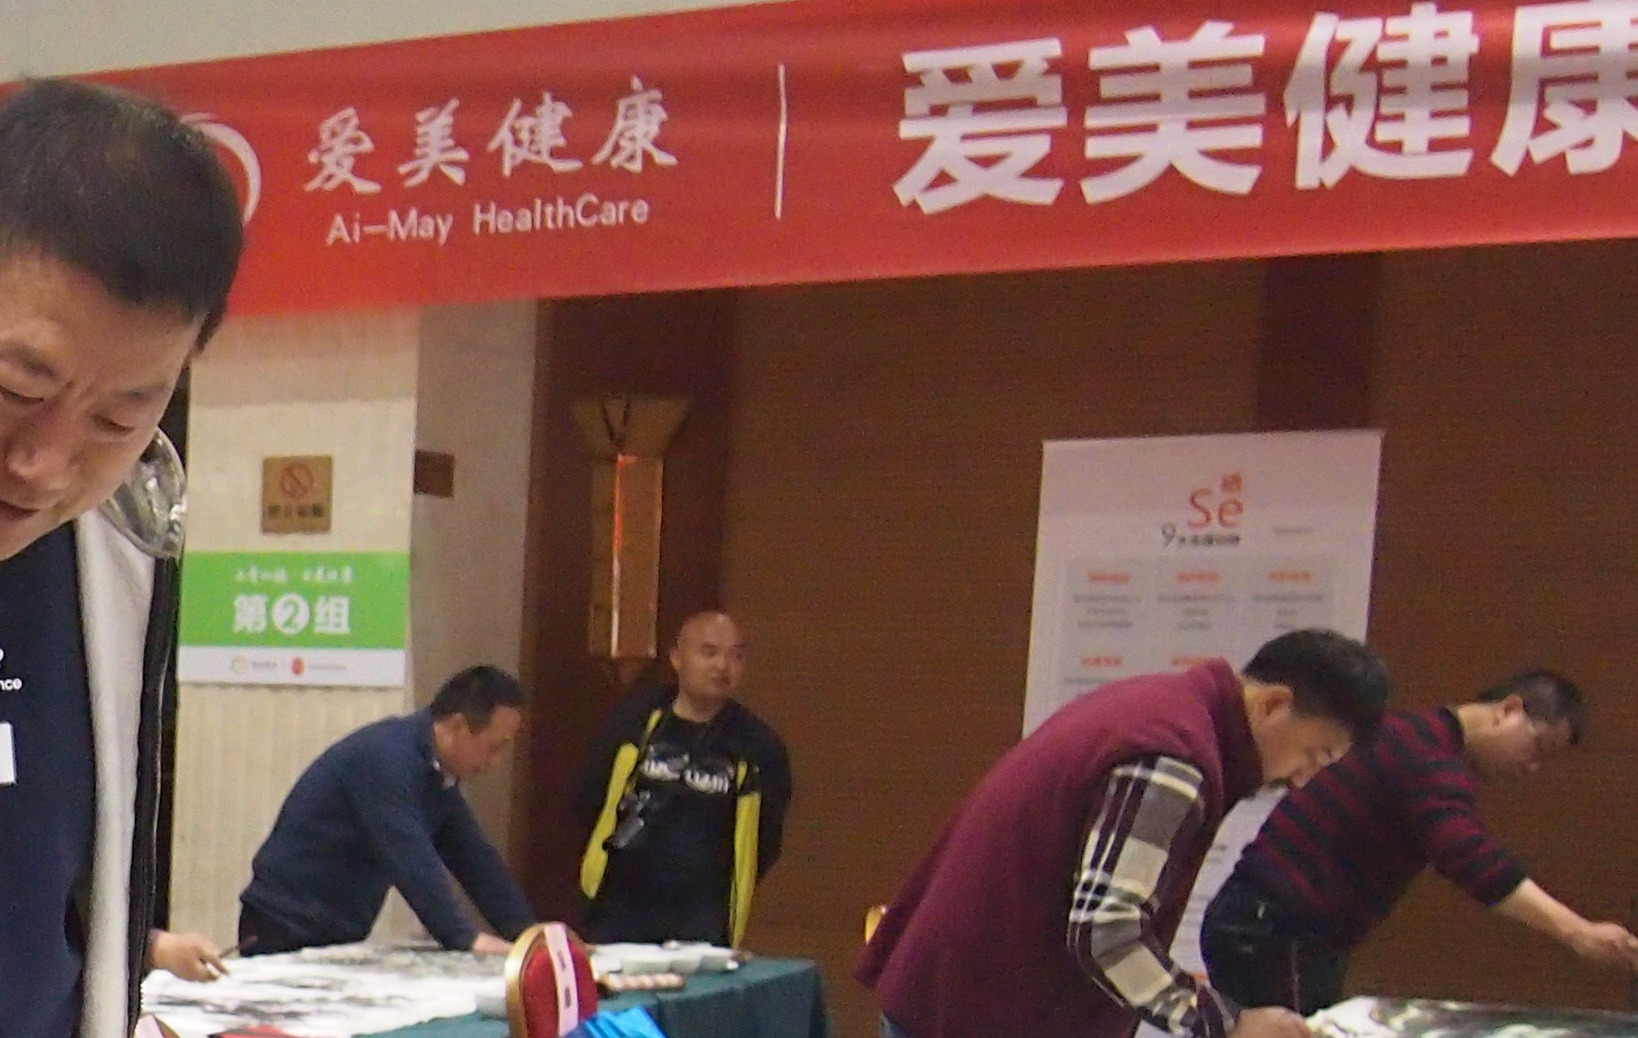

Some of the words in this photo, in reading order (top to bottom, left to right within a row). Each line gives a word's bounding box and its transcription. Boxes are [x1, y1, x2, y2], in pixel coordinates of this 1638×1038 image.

[304, 75, 679, 195] 爱美健康
[892, 0, 1638, 215] 爱美健康
[472, 195, 650, 236] HealthCare
